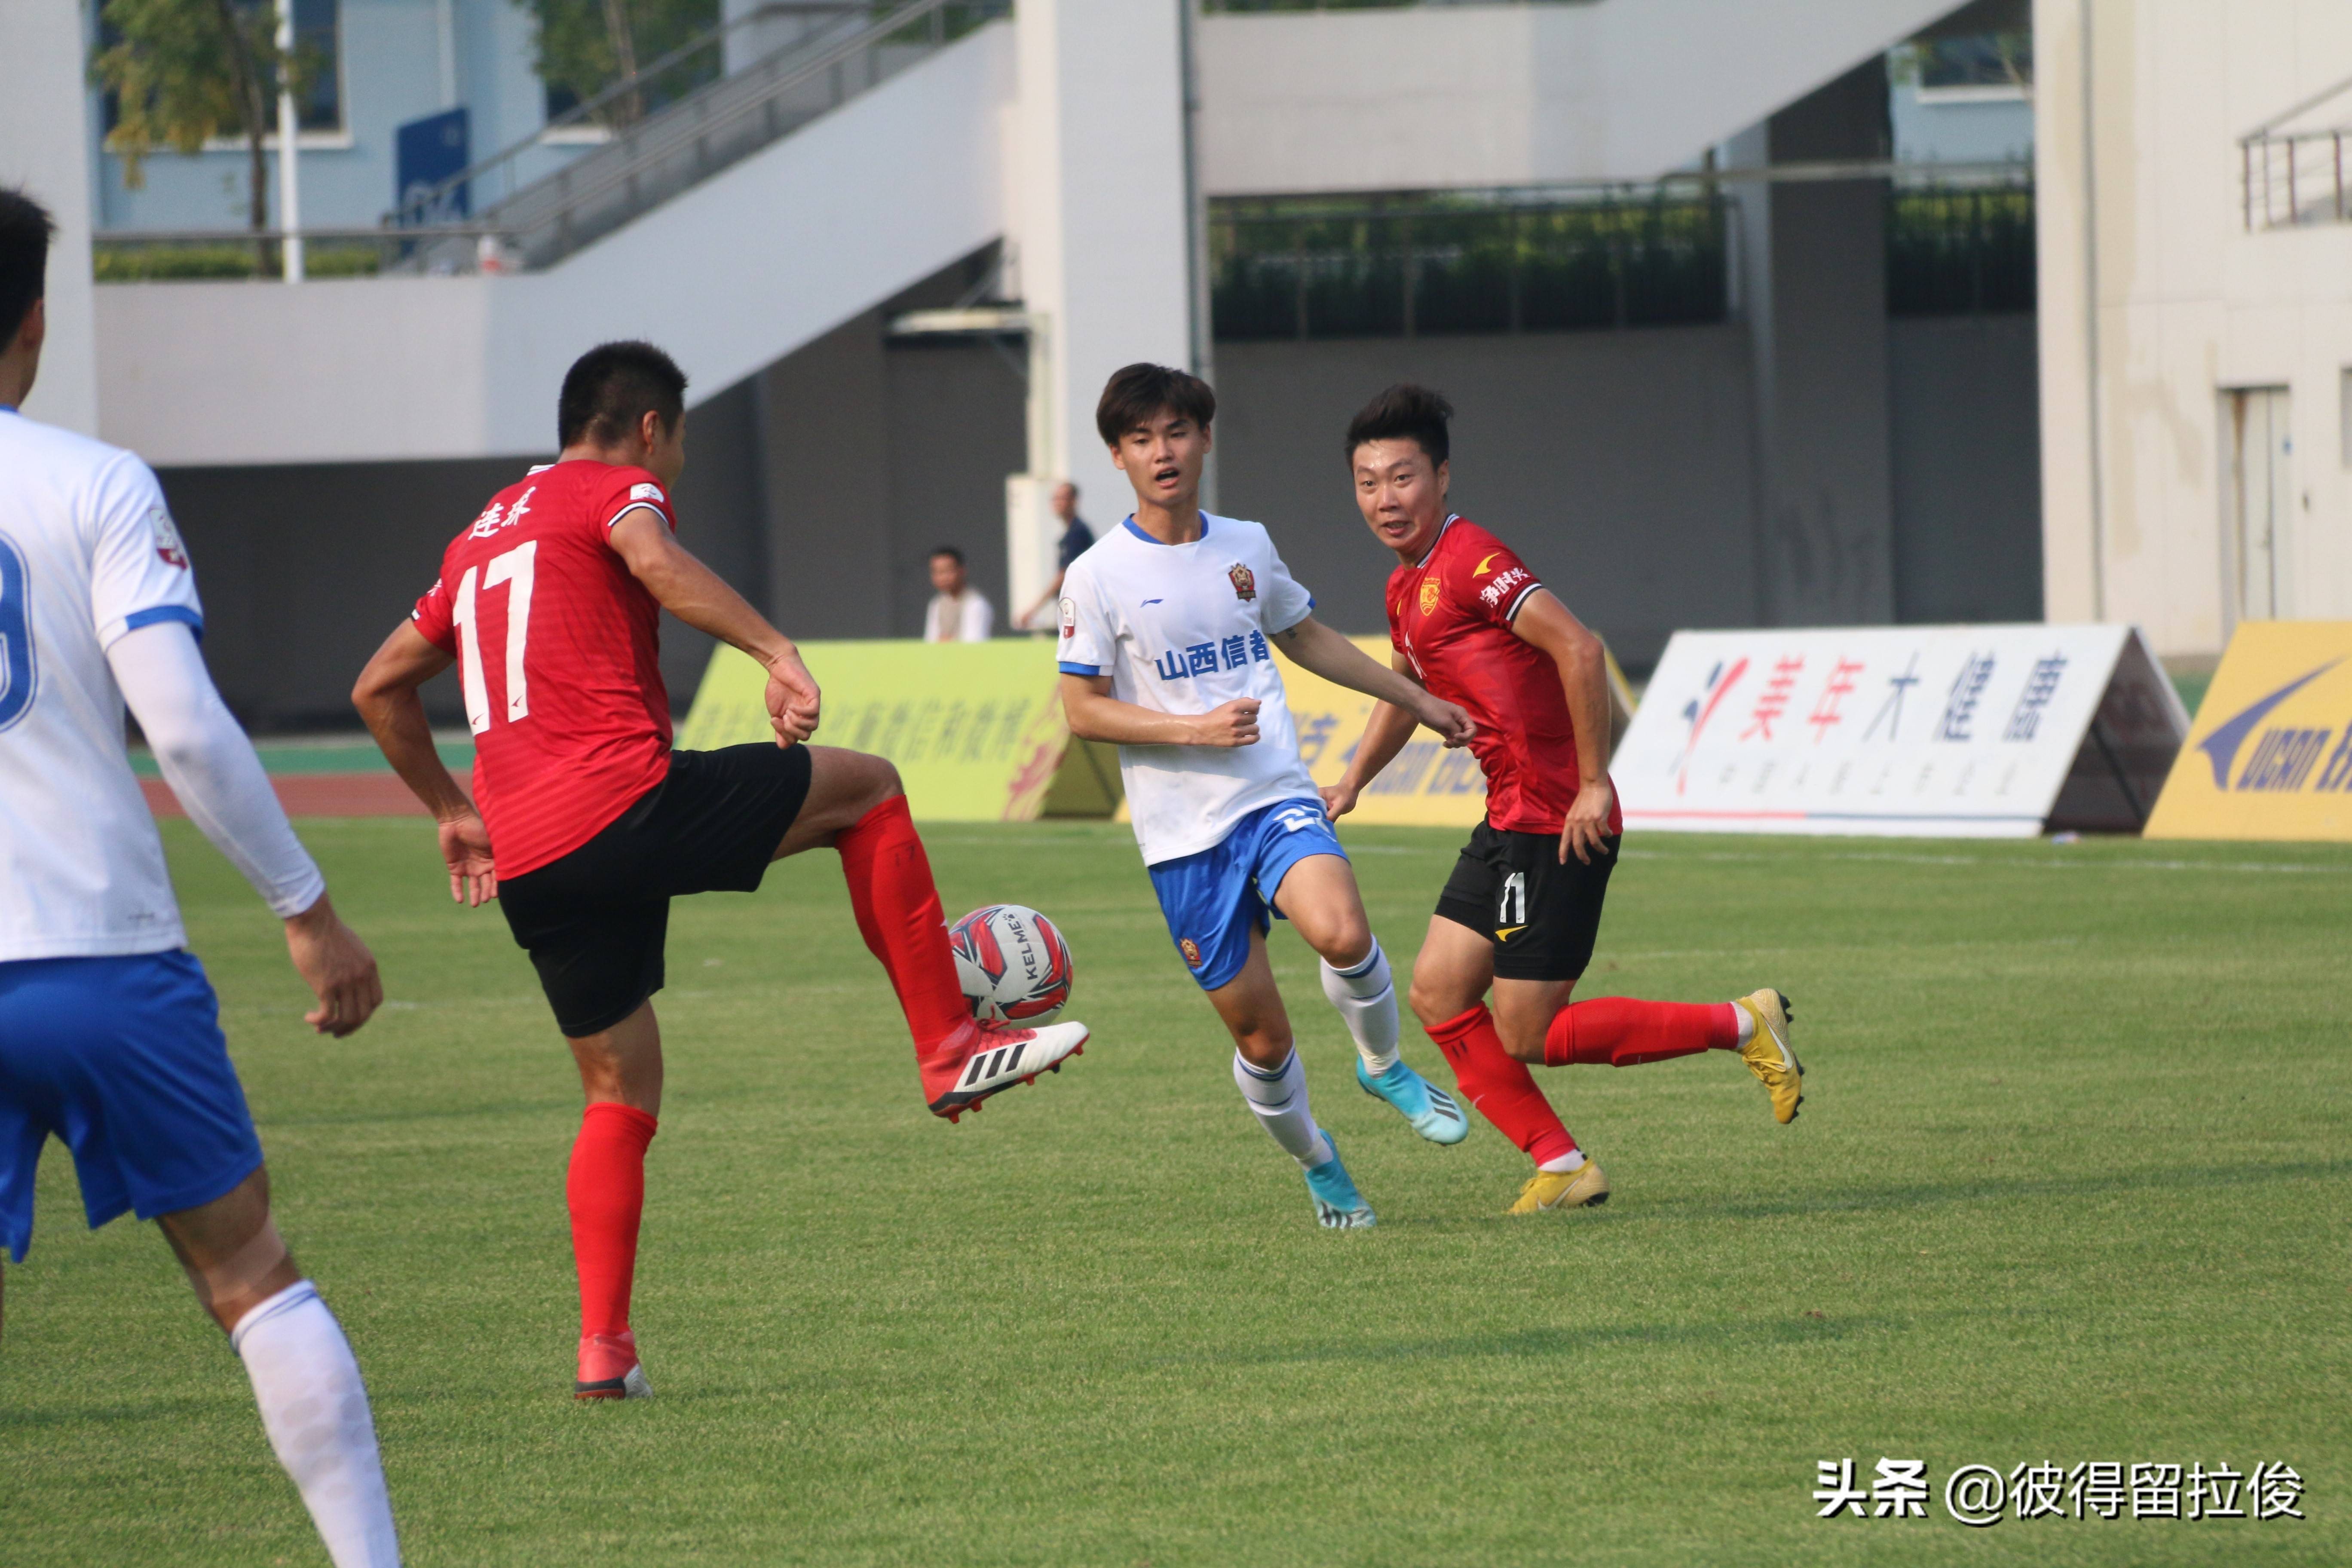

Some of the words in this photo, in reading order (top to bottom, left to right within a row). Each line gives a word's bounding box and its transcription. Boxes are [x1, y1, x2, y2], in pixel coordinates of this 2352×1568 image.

[453, 539, 537, 737] 17
[1739, 648, 2068, 744] 美年大健康
[1500, 872, 1525, 924] 11
[1008, 921, 1038, 980] KELME
